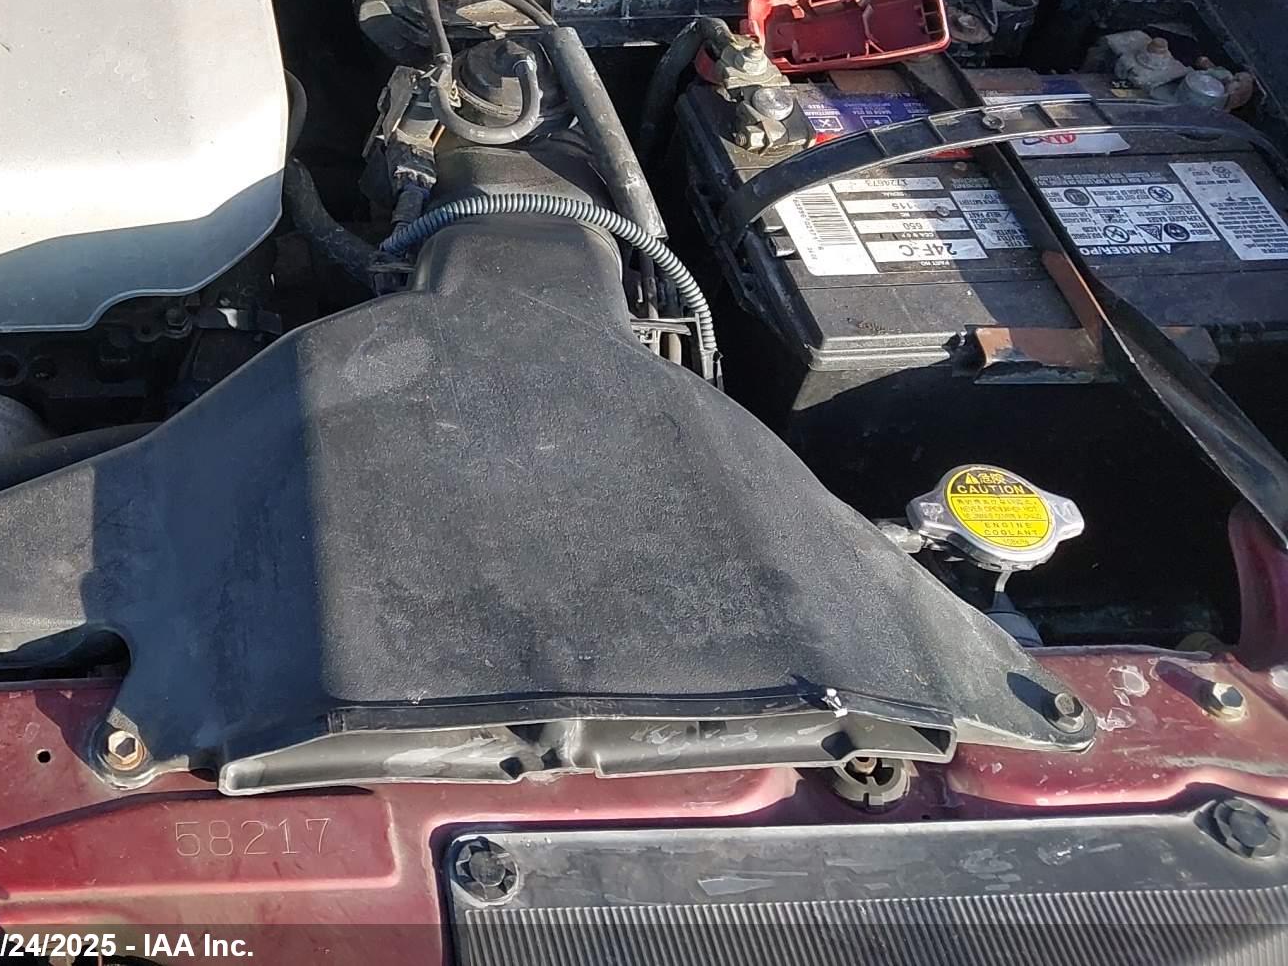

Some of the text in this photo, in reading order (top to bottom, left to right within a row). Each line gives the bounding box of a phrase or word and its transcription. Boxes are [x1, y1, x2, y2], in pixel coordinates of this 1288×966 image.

[898, 242, 958, 257] 24F-C
[957, 484, 1025, 494] CAUTION
[175, 817, 332, 856] 58217
